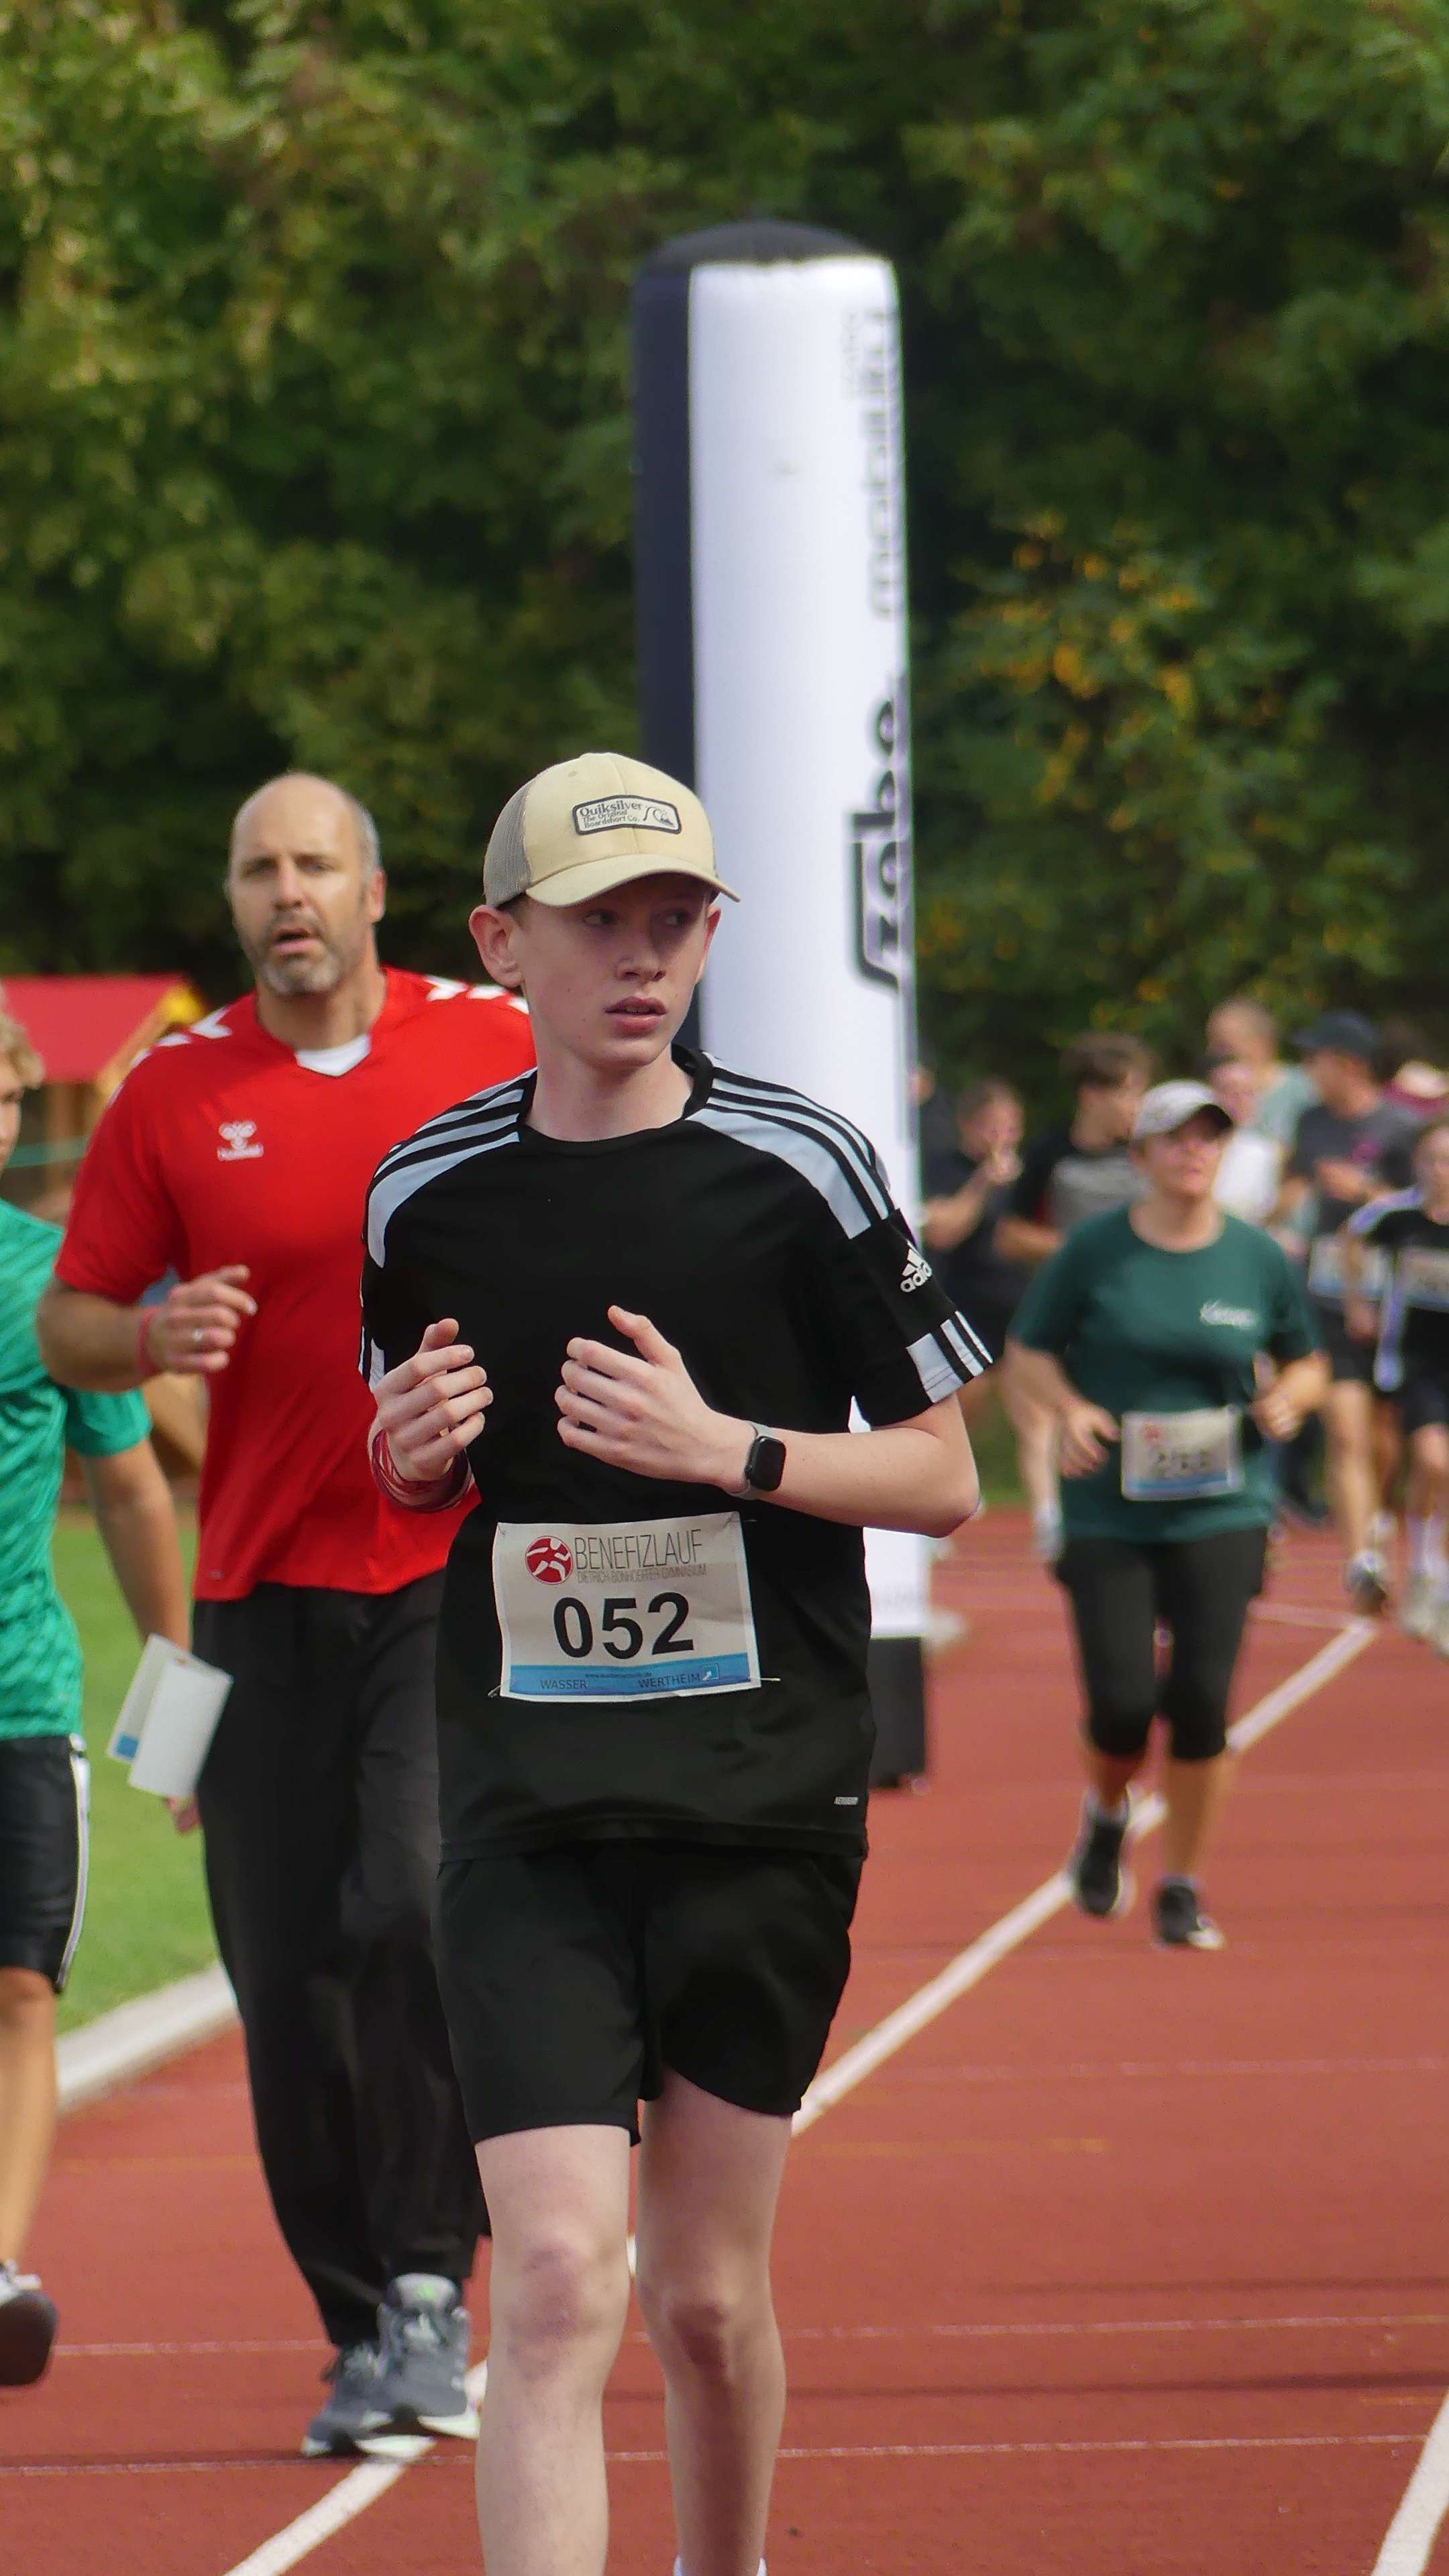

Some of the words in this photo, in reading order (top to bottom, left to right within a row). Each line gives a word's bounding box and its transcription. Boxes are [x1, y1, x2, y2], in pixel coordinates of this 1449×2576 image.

[580, 800, 642, 817] Quiksilver
[574, 1529, 702, 1570] BENEFIZLAUF
[553, 1591, 695, 1660] 052
[540, 1679, 588, 1690] WASSER
[639, 1672, 700, 1689] WERTHEIM
